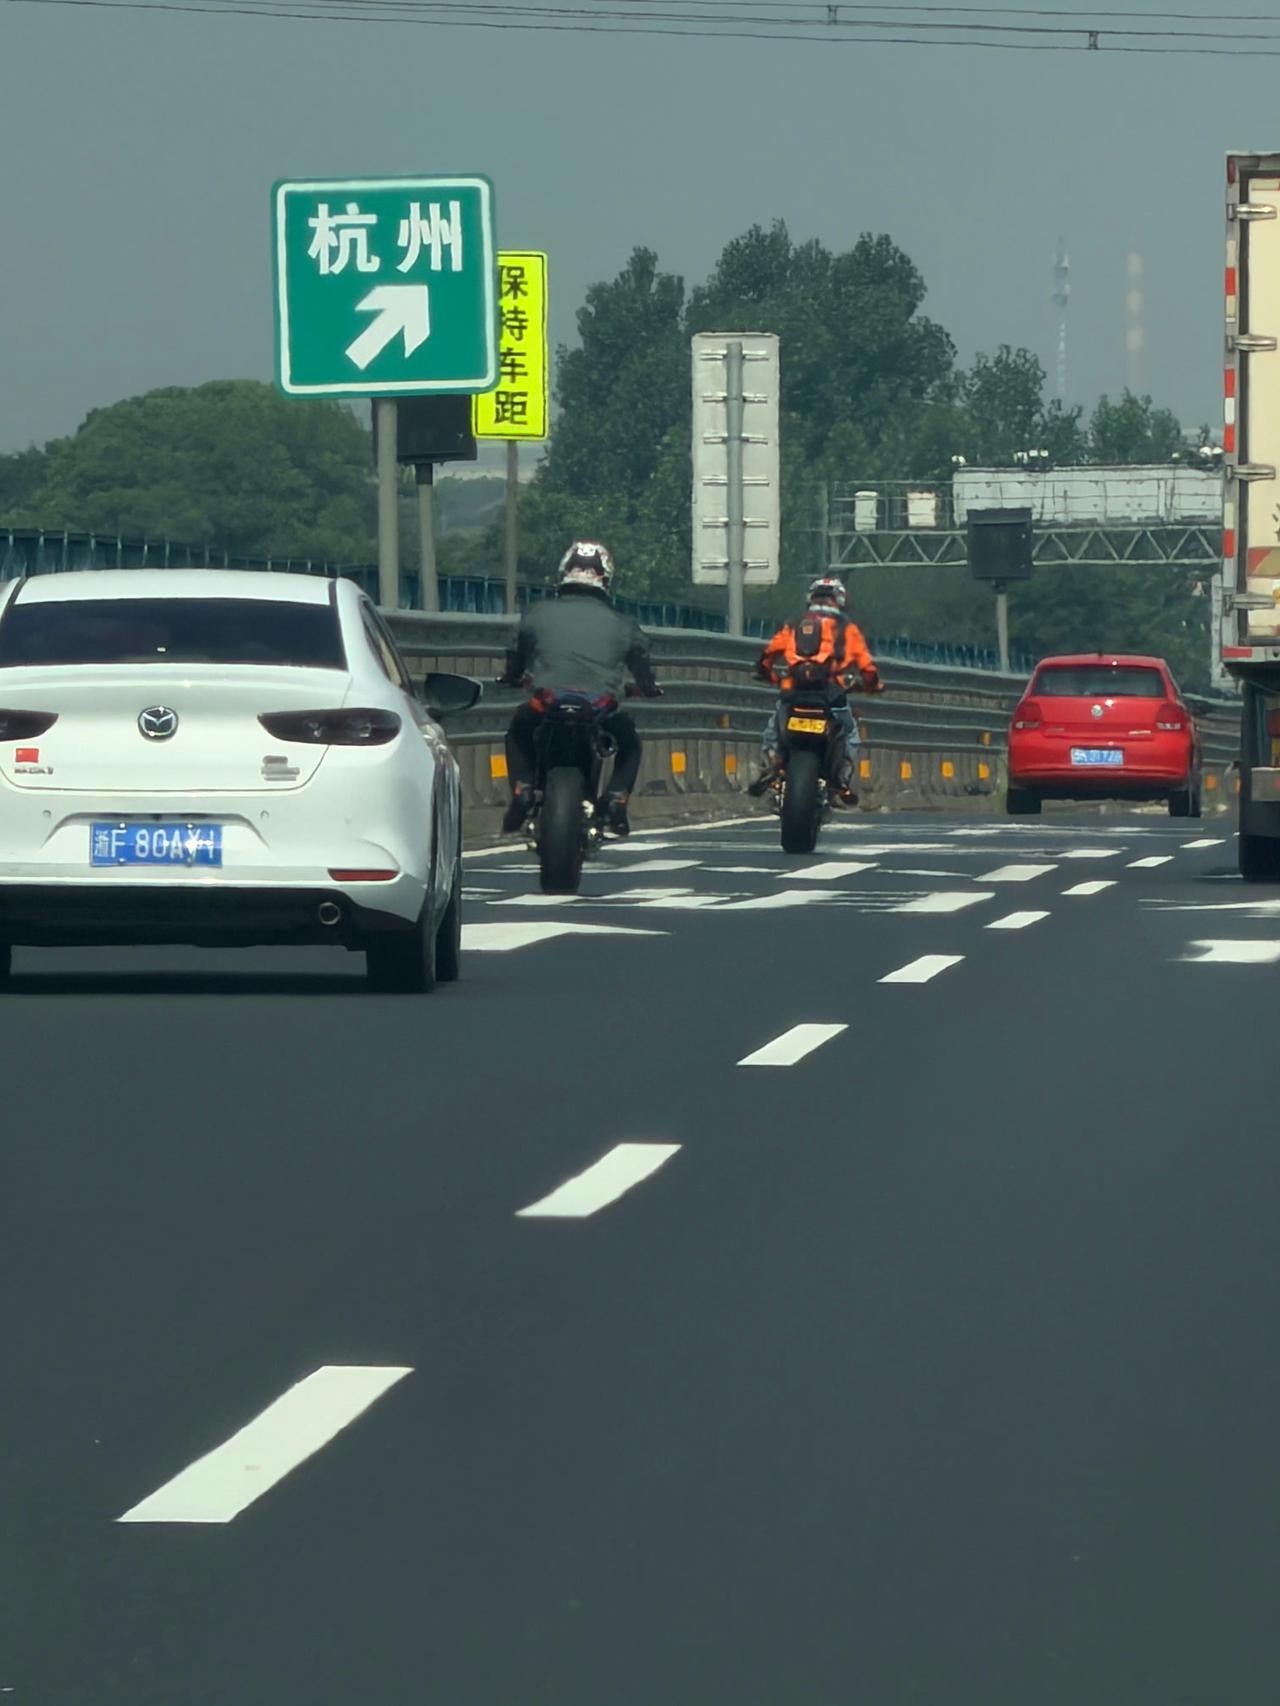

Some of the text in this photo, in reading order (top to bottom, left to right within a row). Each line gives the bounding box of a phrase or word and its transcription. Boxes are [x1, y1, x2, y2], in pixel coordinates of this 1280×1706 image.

[308, 201, 463, 274] 杭州
[495, 266, 528, 425] 保持车距
